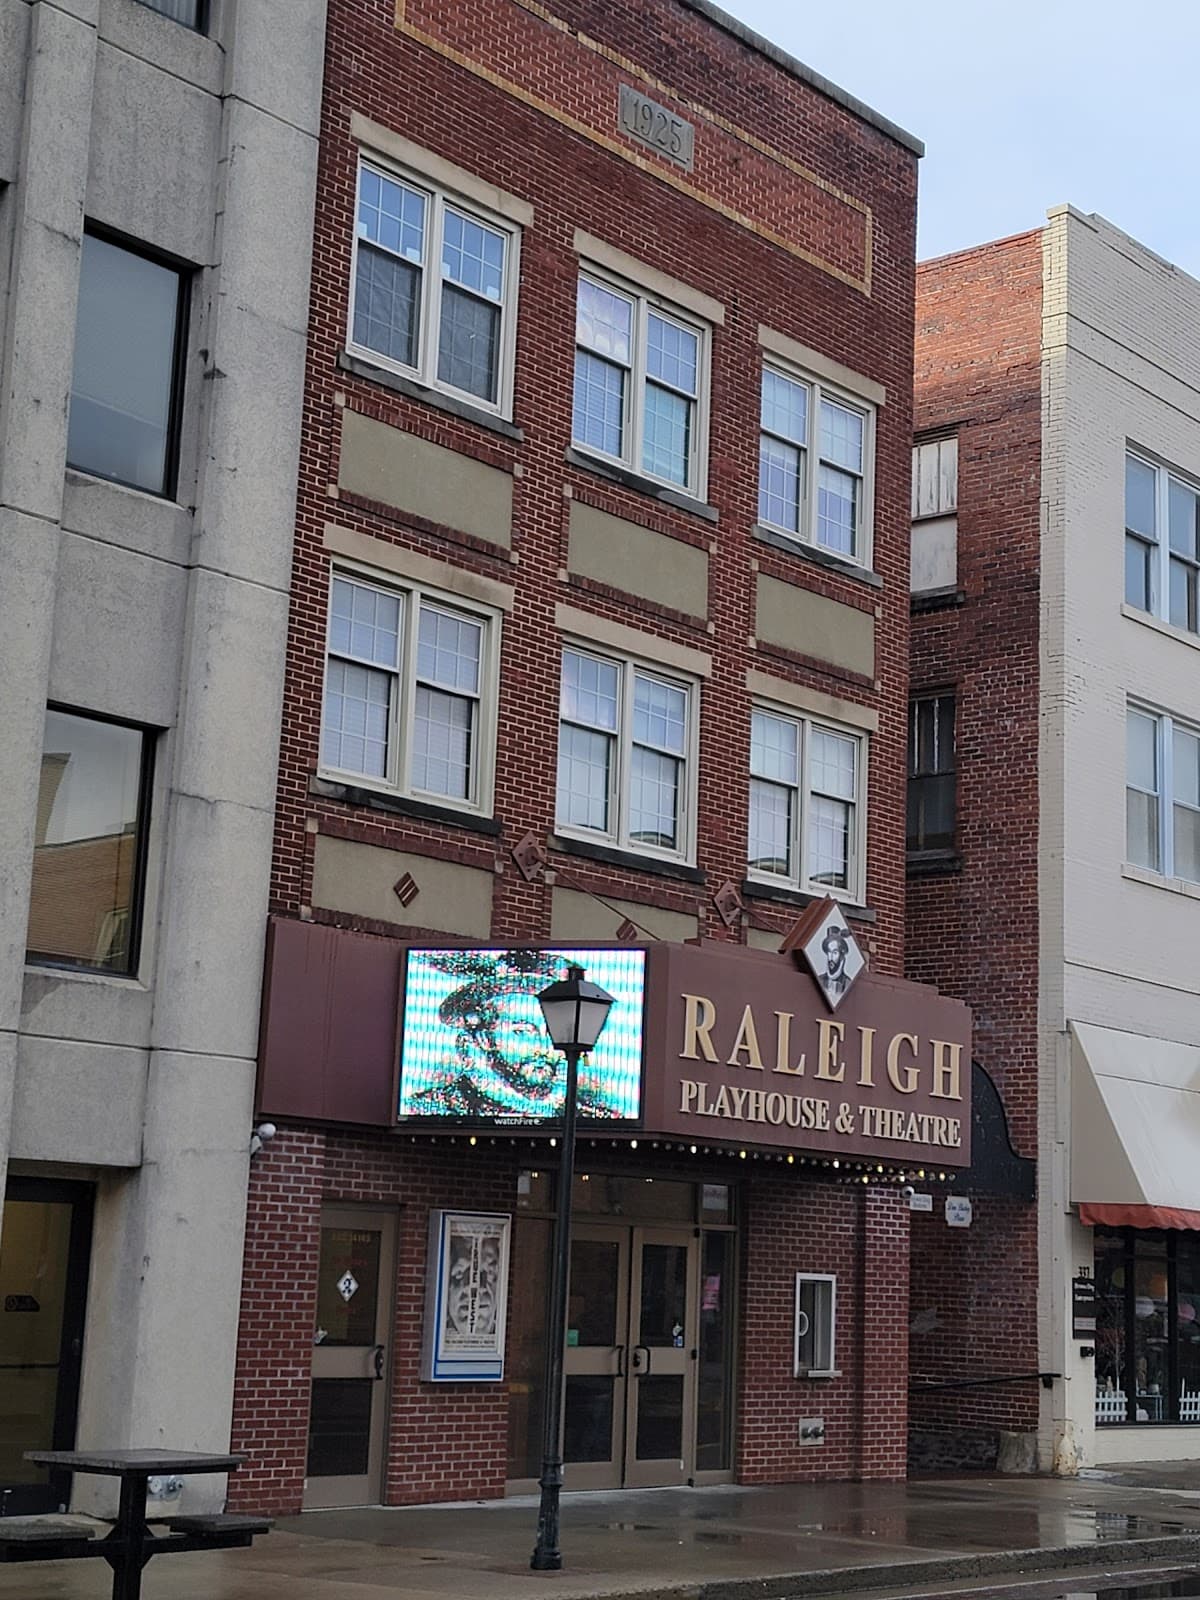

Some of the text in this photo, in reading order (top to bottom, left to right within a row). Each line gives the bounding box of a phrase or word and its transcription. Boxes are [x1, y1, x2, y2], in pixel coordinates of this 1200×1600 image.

[633, 98, 682, 153] 1925
[679, 993, 964, 1101] RALEIGH
[680, 1079, 961, 1148] PLAYHOUSE & THEATRE
